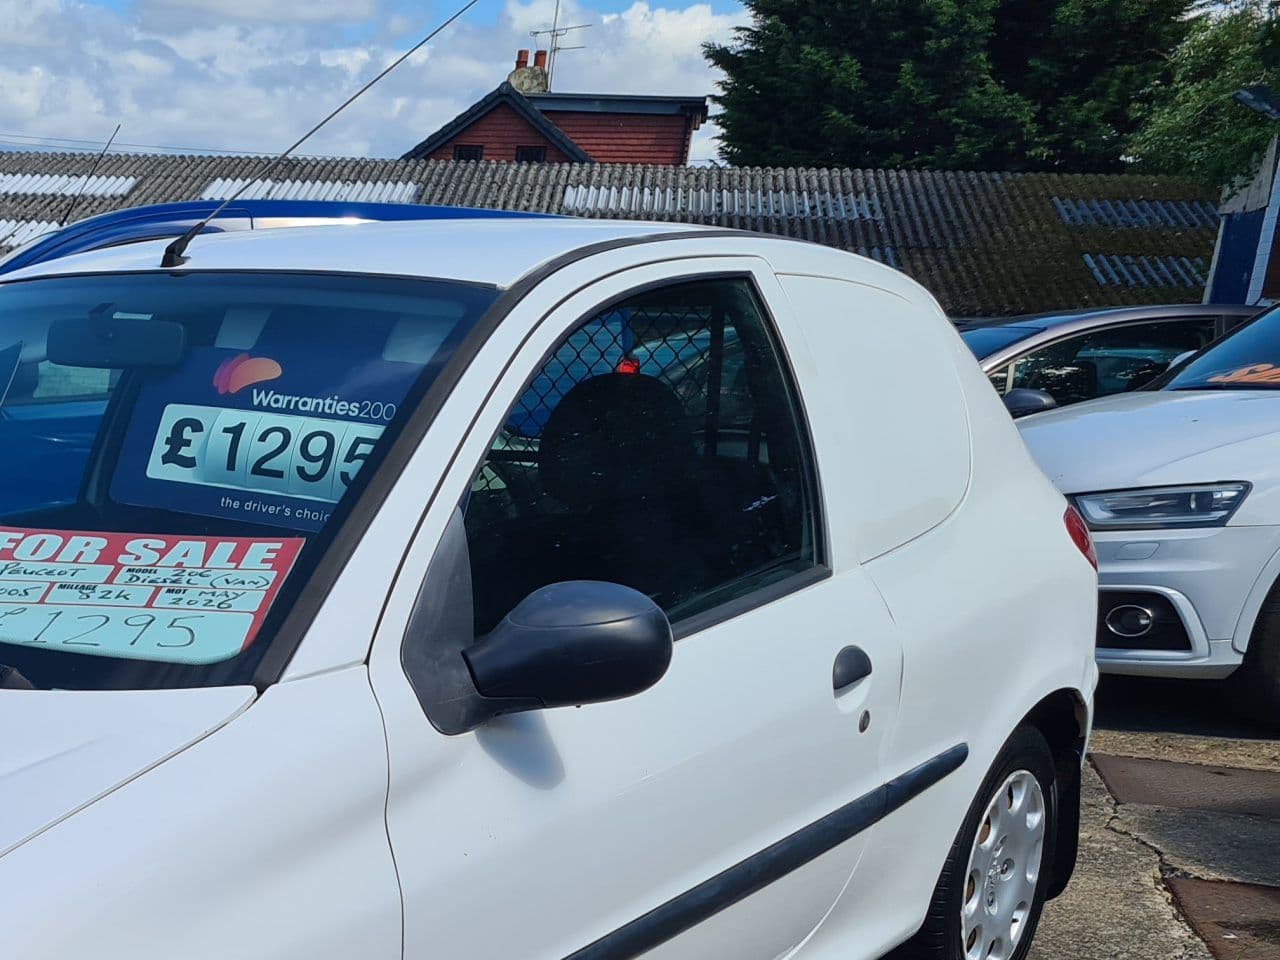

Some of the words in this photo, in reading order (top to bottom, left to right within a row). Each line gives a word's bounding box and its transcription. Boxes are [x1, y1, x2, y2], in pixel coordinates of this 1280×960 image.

[161, 417, 378, 487] £1295
[220, 496, 241, 509] the
[244, 500, 291, 517] driver's
[295, 508, 331, 521] choic
[116, 538, 283, 570] SALE
[57, 583, 99, 591] MILEAGE
[168, 597, 233, 610] 2026
